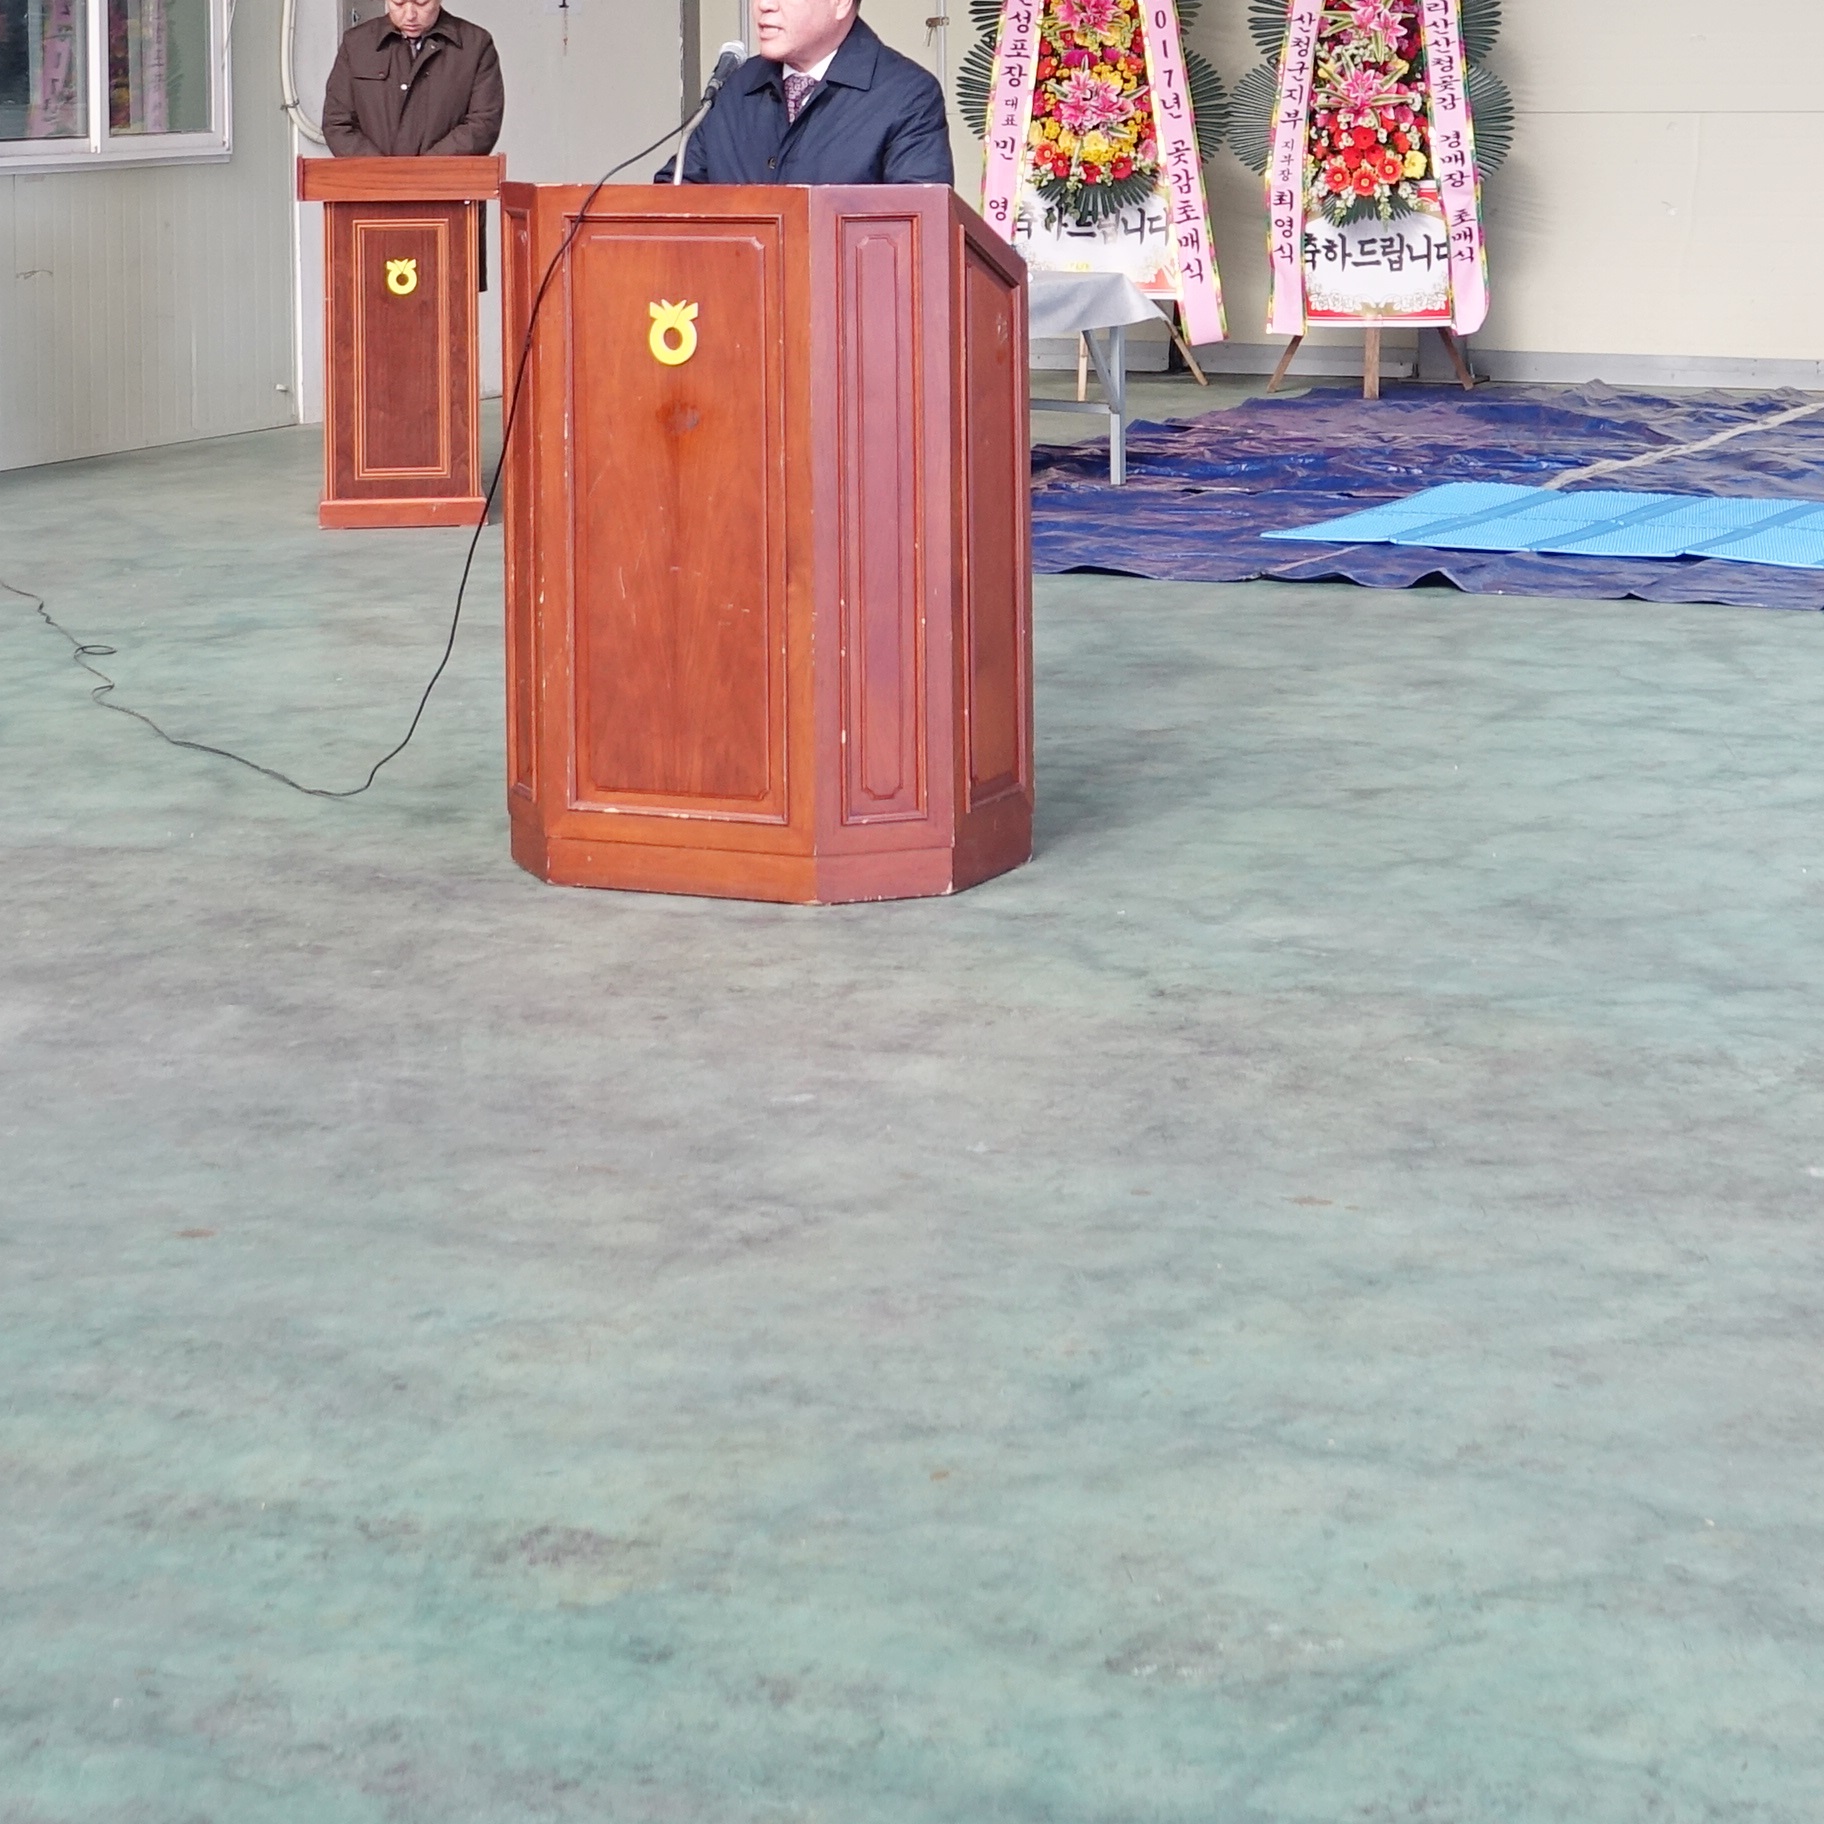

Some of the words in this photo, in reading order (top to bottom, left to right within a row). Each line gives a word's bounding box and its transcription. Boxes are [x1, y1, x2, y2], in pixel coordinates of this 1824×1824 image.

[1280, 11, 1316, 131] 산청군지부
[1000, 96, 1019, 127] 대표
[1278, 138, 1295, 183] 지부장
[1439, 130, 1471, 189] 경매장
[1273, 188, 1295, 265] 최영식
[1450, 208, 1477, 265] 초매식
